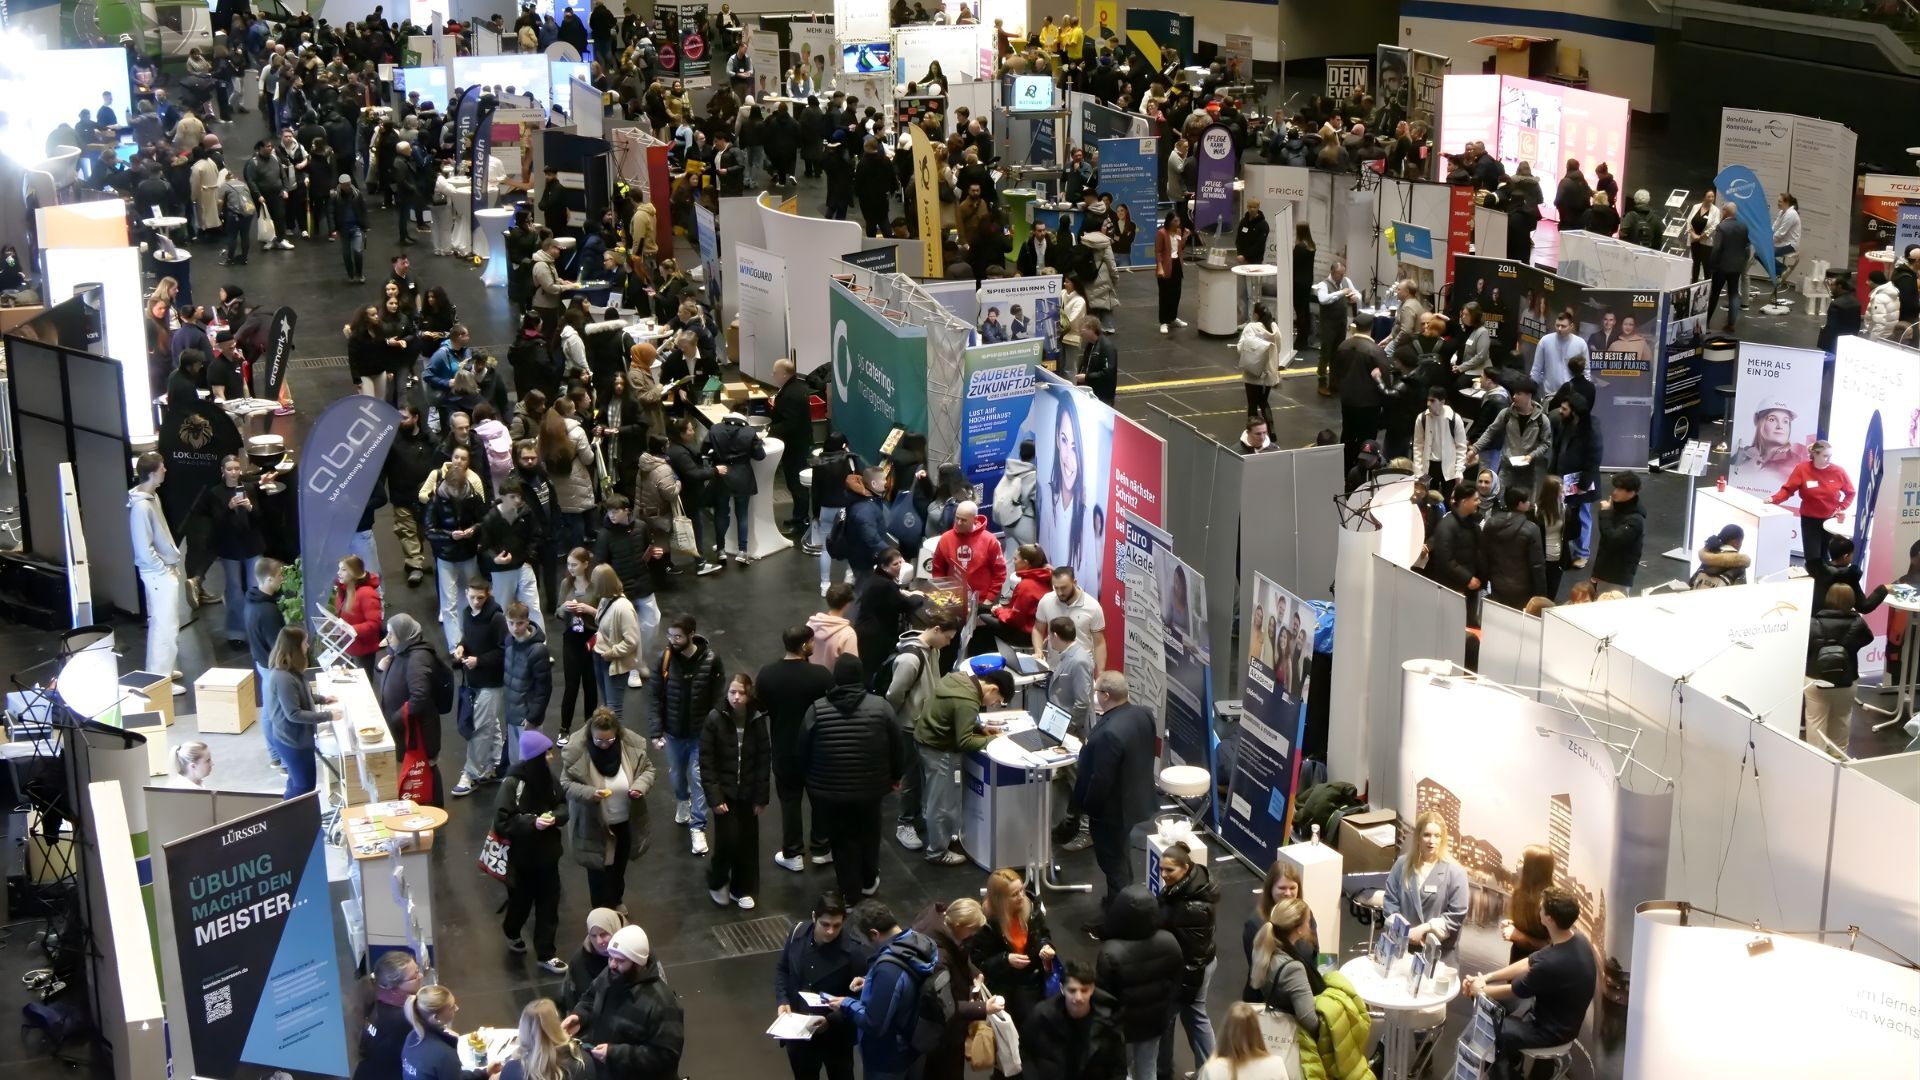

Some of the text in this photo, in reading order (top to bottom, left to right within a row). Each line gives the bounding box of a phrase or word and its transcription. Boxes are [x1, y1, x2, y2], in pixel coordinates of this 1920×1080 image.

[1328, 67, 1366, 86] DEIN
[1206, 135, 1228, 143] PFLEGE
[1268, 187, 1304, 197] FRICKE
[1498, 264, 1518, 274] ZOLL
[1632, 294, 1656, 303] ZOLL
[269, 335, 286, 386] aramark
[1604, 352, 1623, 361] BESTE
[1747, 358, 1791, 371] MEHR ALS
[972, 366, 1026, 384] SAUBERE
[1746, 368, 1780, 378] EIN JOB
[969, 376, 1036, 397] ZUKUNFT.DE
[968, 407, 998, 417] LUST AUF
[968, 415, 985, 424] HOCH
[327, 487, 342, 502] SAP
[338, 462, 364, 490] Beratung
[362, 423, 394, 459] Entwicklung
[1115, 468, 1156, 504] Dein nächster
[1115, 485, 1138, 509] Schritt?
[1115, 501, 1126, 518] Dei
[1115, 516, 1126, 533] bei
[1126, 522, 1148, 549] Euro
[1125, 545, 1155, 576] Akade
[1568, 739, 1588, 763] ZECH
[222, 821, 268, 847] LÜRSSEN
[189, 853, 273, 901] ÜBUNG
[191, 870, 292, 922] MACHT DEN
[194, 892, 308, 947] MEISTER...
